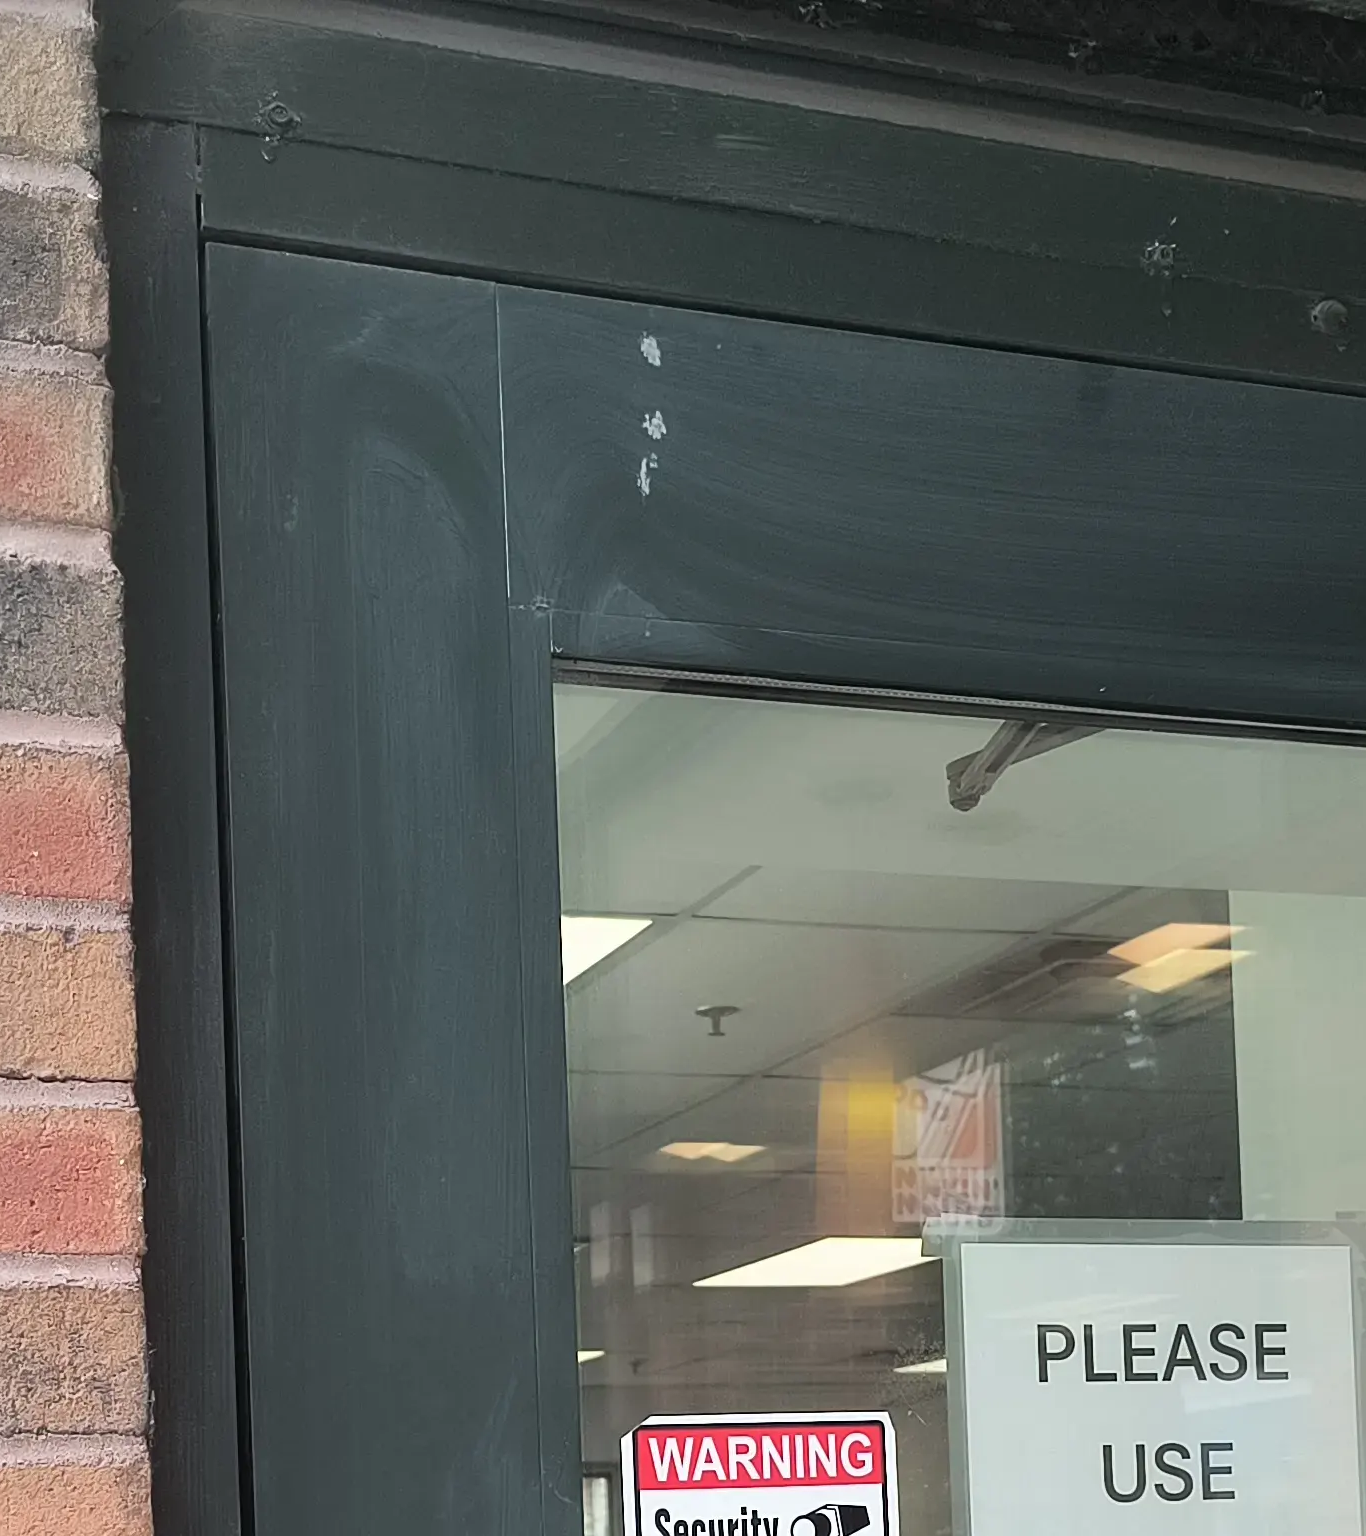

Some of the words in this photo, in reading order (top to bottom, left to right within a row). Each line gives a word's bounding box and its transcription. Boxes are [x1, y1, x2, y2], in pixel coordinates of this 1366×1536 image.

[1036, 1322, 1290, 1384] PLEASE
[647, 1432, 874, 1483] WARNING
[1101, 1442, 1236, 1503] USE
